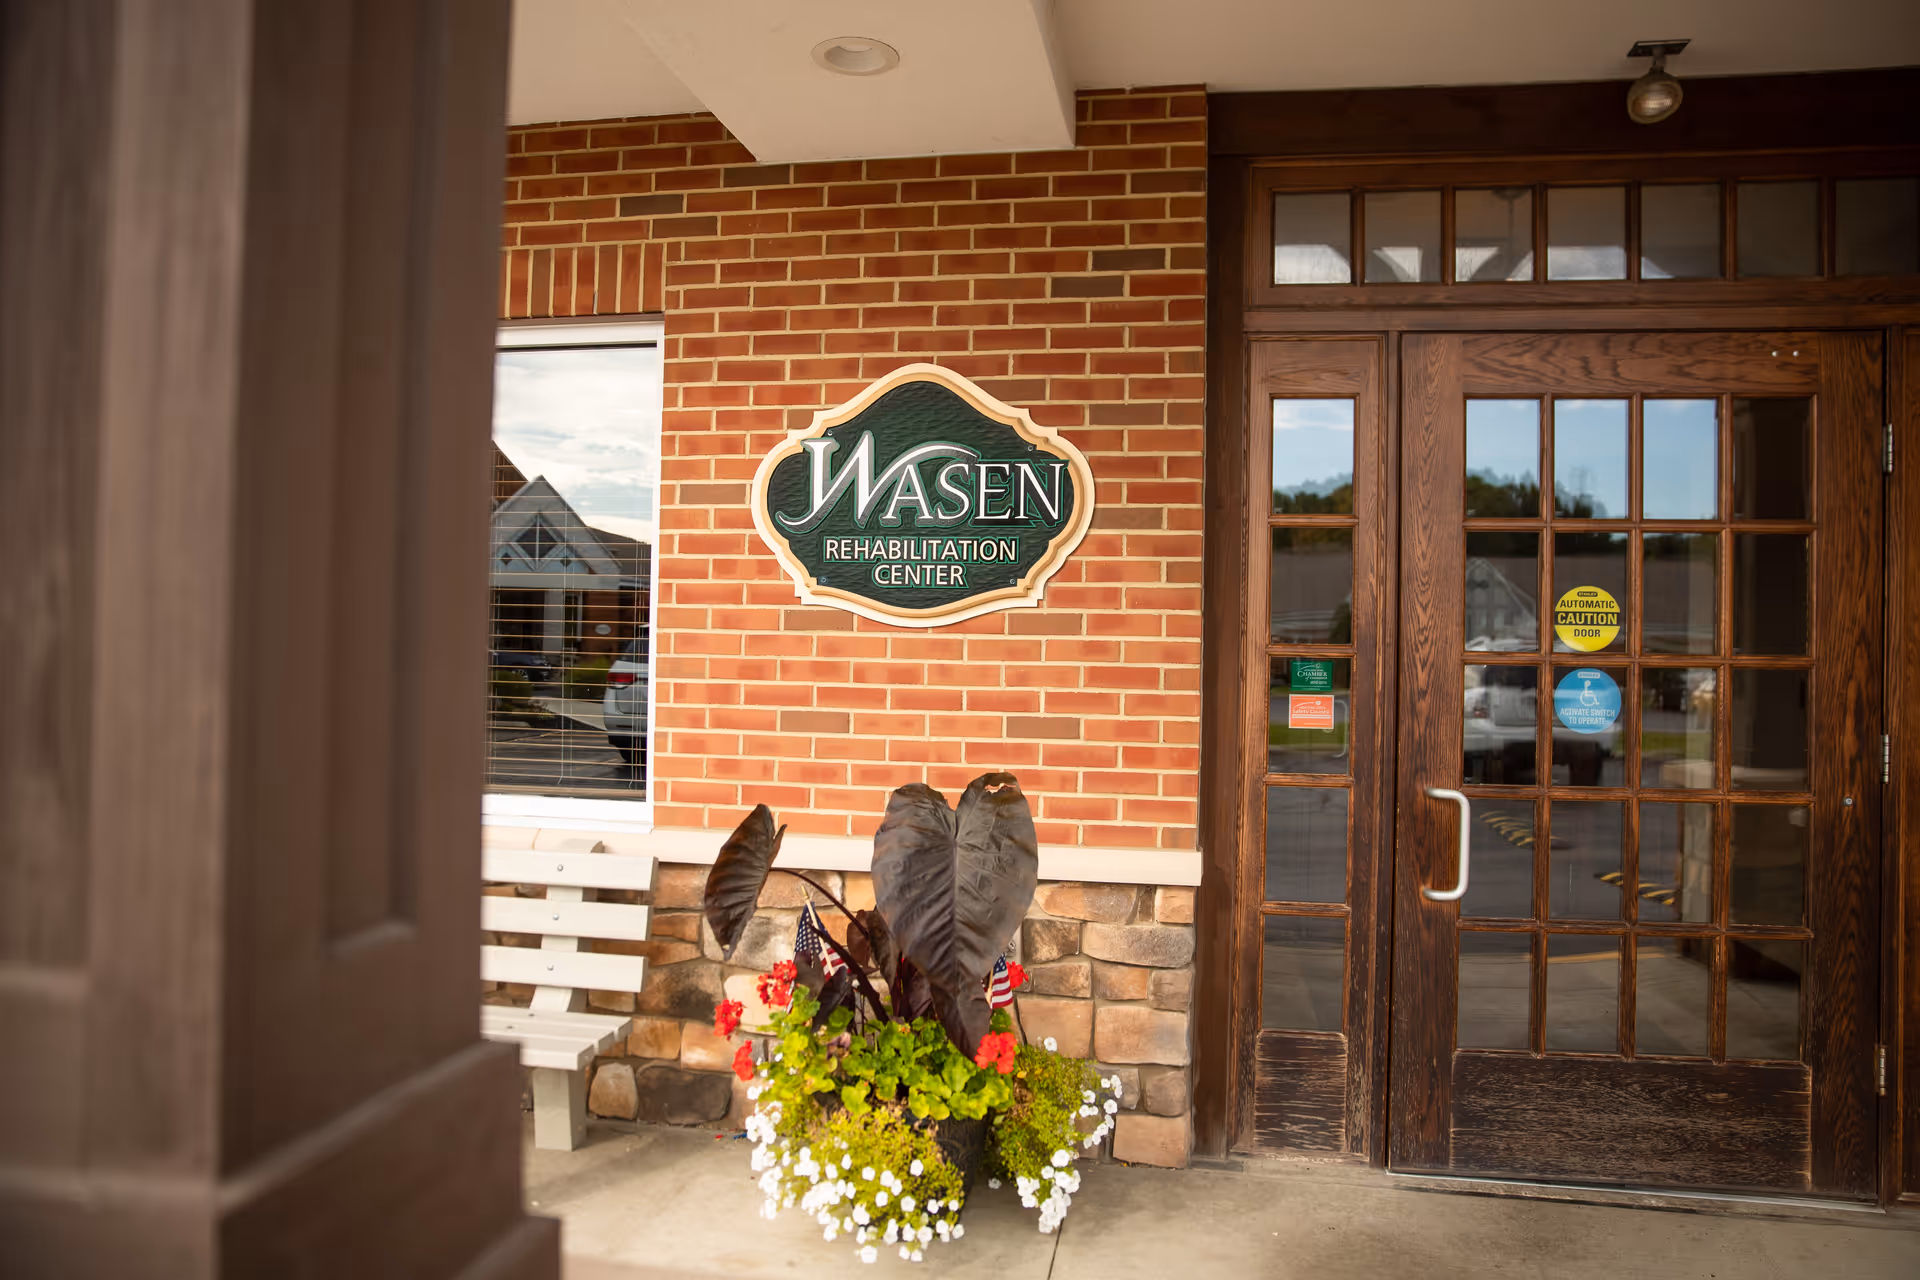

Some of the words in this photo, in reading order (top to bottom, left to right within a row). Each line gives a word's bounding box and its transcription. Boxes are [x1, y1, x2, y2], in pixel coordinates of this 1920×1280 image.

[777, 432, 1066, 528] WASEN
[825, 538, 1017, 562] REHABILITATION
[873, 563, 967, 586] CENTER
[1559, 600, 1615, 609] AUTOMATIC
[1557, 612, 1618, 625] CAUTION
[1573, 629, 1601, 637] DOOR
[1560, 708, 1590, 716] ACTIVATE
[1590, 709, 1616, 717] SWITCH
[1569, 716, 1577, 724] TO
[1578, 717, 1605, 725] OPERATE
